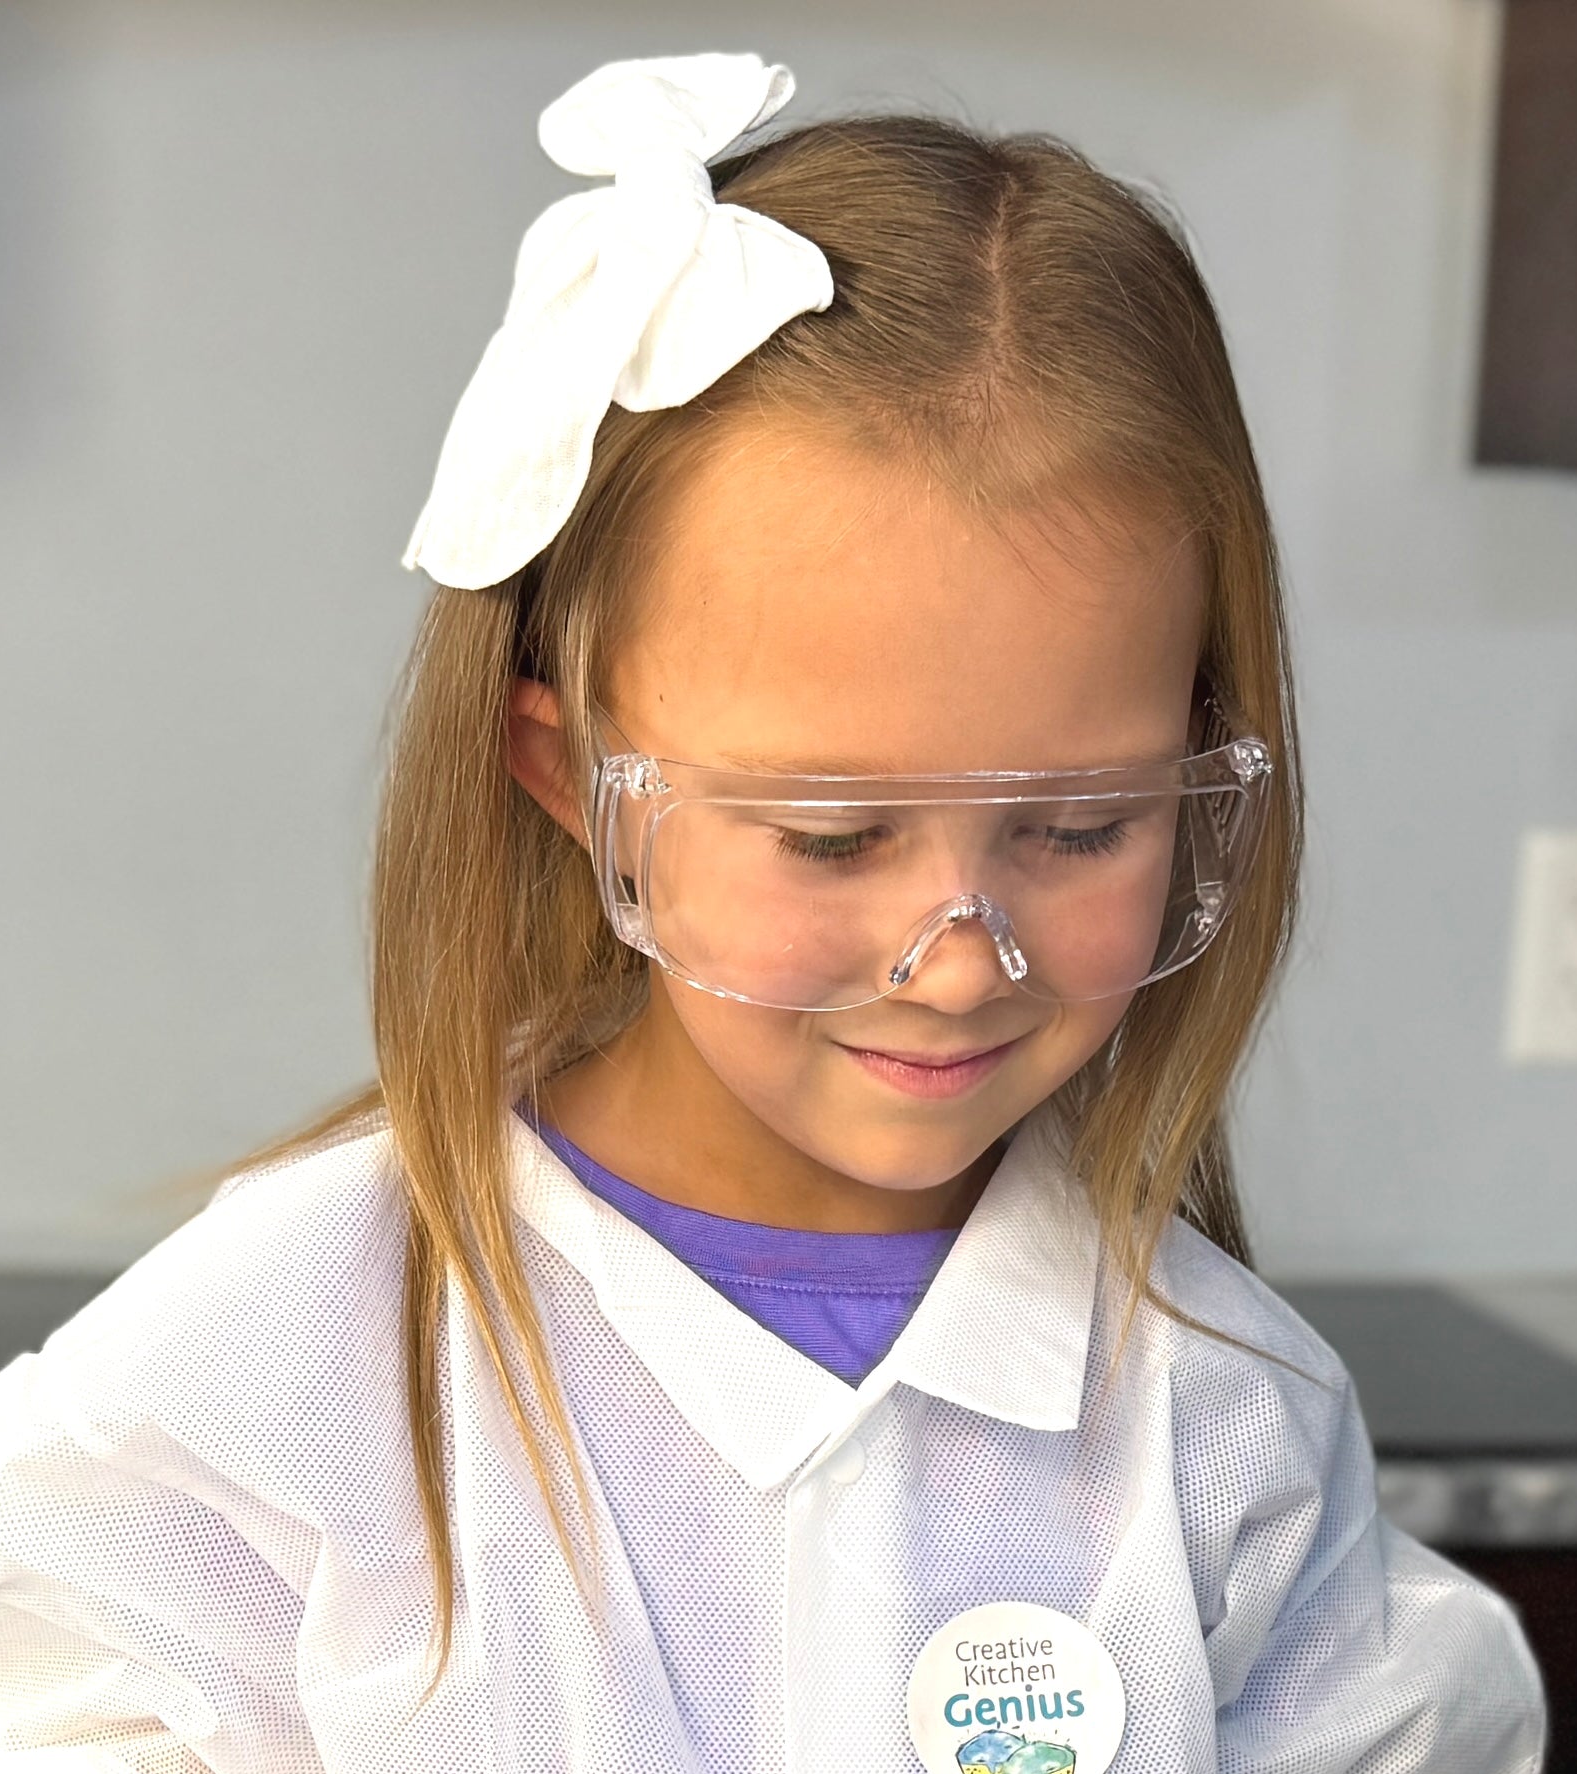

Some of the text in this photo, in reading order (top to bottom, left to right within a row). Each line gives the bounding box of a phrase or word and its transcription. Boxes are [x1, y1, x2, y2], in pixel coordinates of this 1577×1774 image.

[955, 1637, 1053, 1662] Creative
[964, 1661, 1055, 1687] Kitchen
[944, 1684, 1085, 1727] Genius
